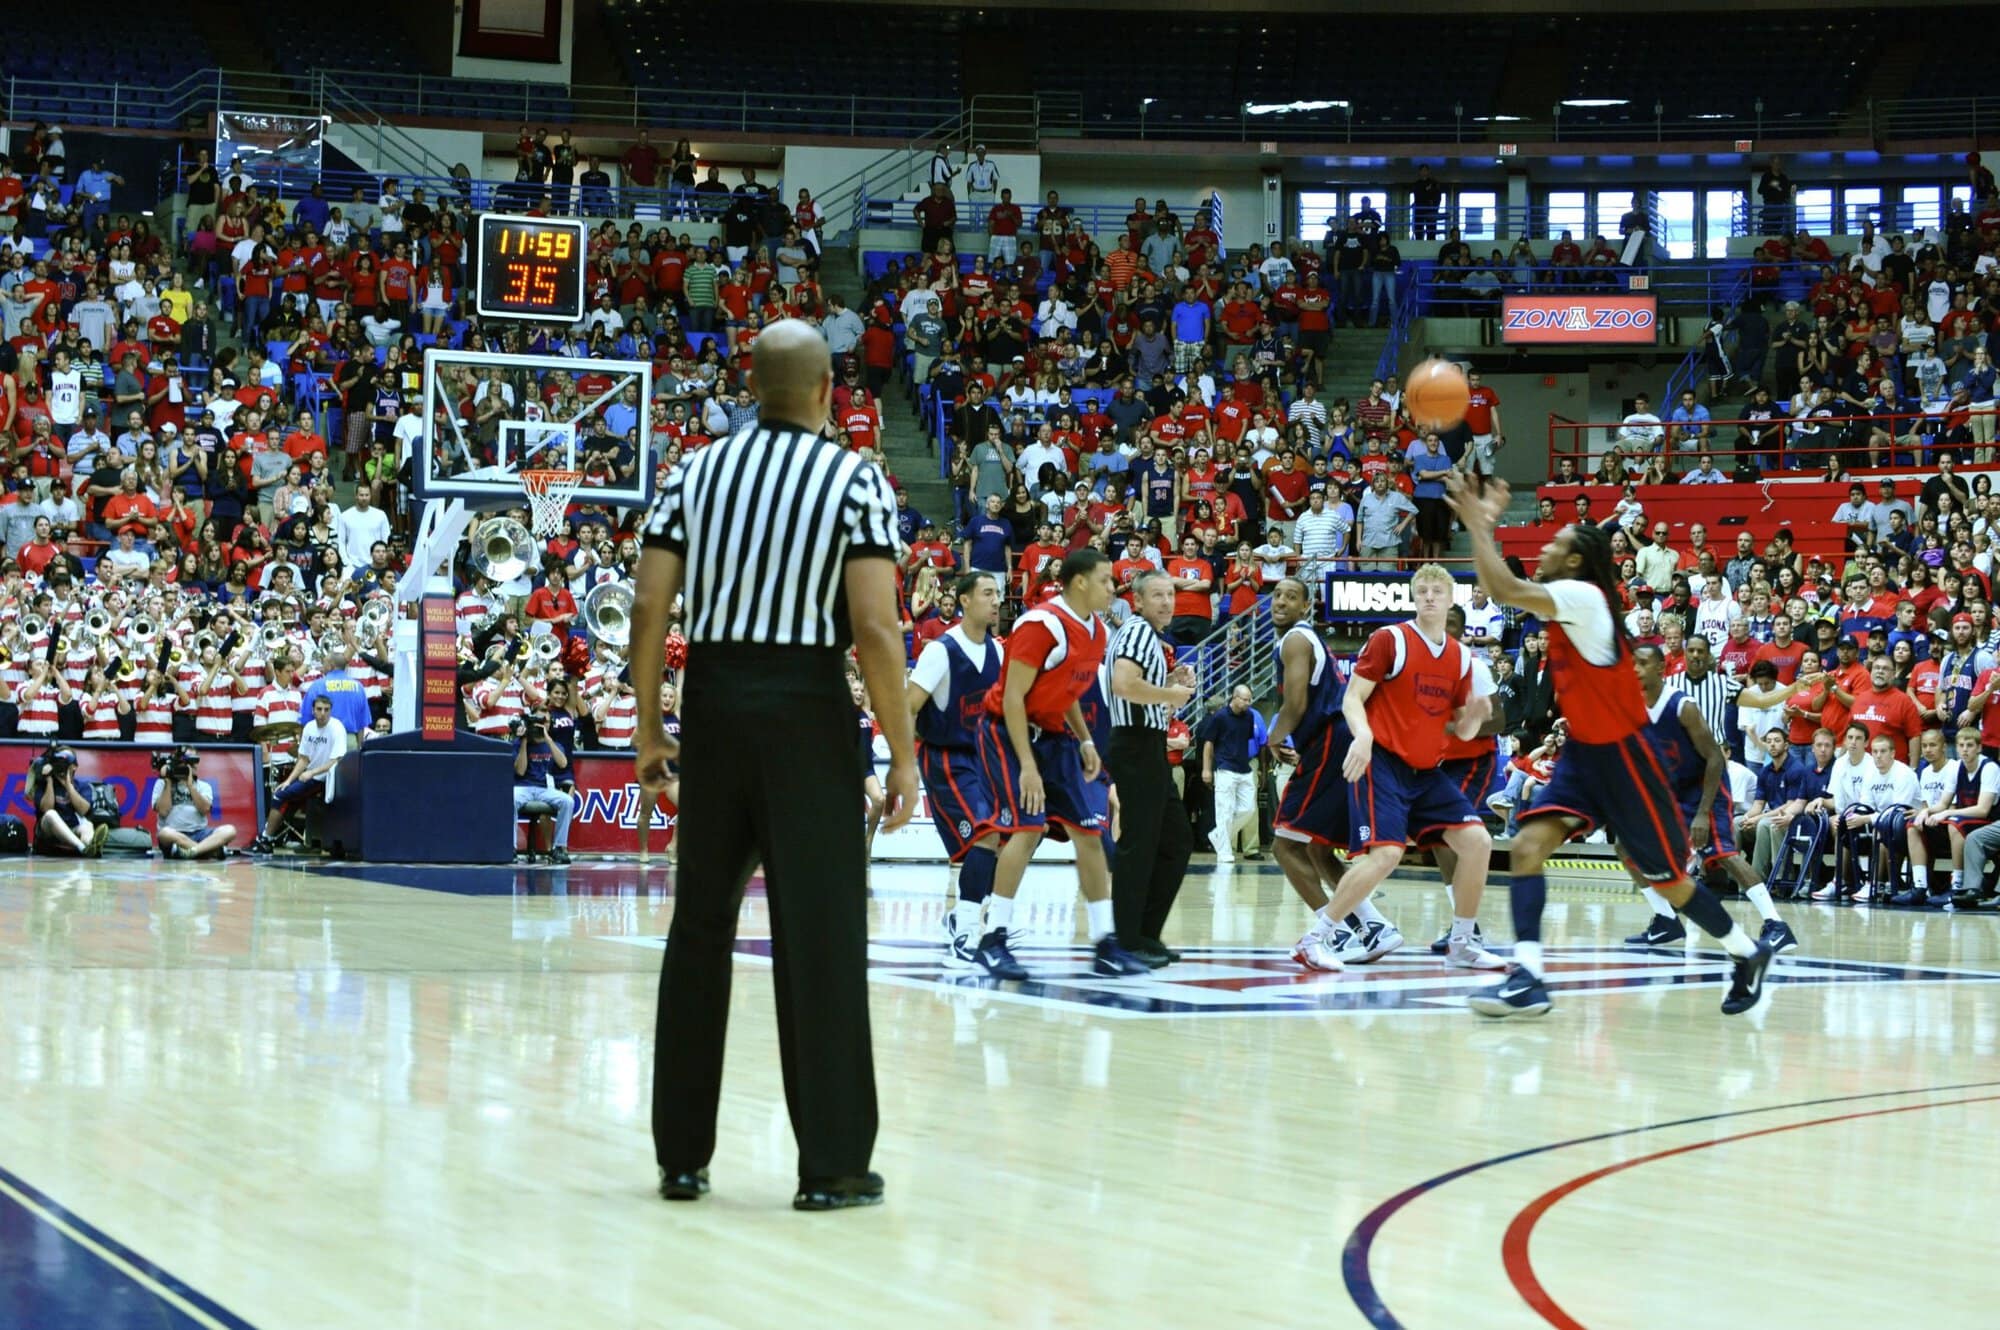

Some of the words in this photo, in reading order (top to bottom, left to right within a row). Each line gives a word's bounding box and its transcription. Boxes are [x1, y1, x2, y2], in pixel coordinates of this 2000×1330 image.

[501, 229, 571, 258] 11:59
[504, 264, 557, 304] 35
[1632, 277, 1645, 287] EXIT
[1592, 309, 1654, 329] ZOO
[61, 393, 72, 402] 43
[1332, 581, 1417, 611] MUSCL
[326, 679, 359, 692] SECURITY
